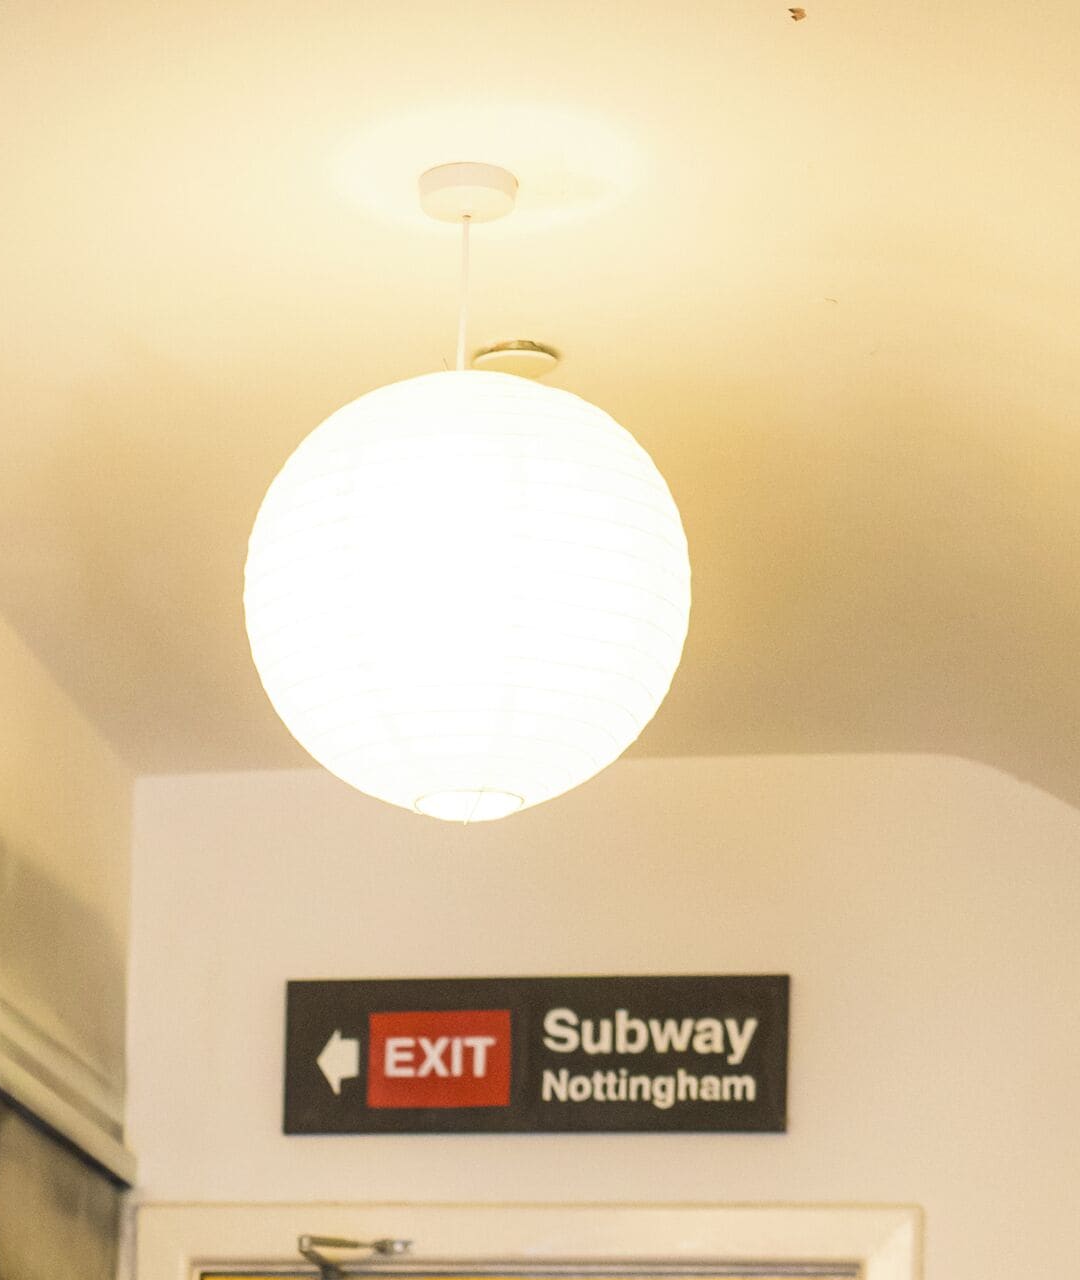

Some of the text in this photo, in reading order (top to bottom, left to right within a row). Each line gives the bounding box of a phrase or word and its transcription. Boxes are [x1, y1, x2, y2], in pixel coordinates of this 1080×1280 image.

[384, 1036, 497, 1079] EXIT
[542, 1008, 758, 1064] Subway
[541, 1068, 757, 1109] Nottingham
